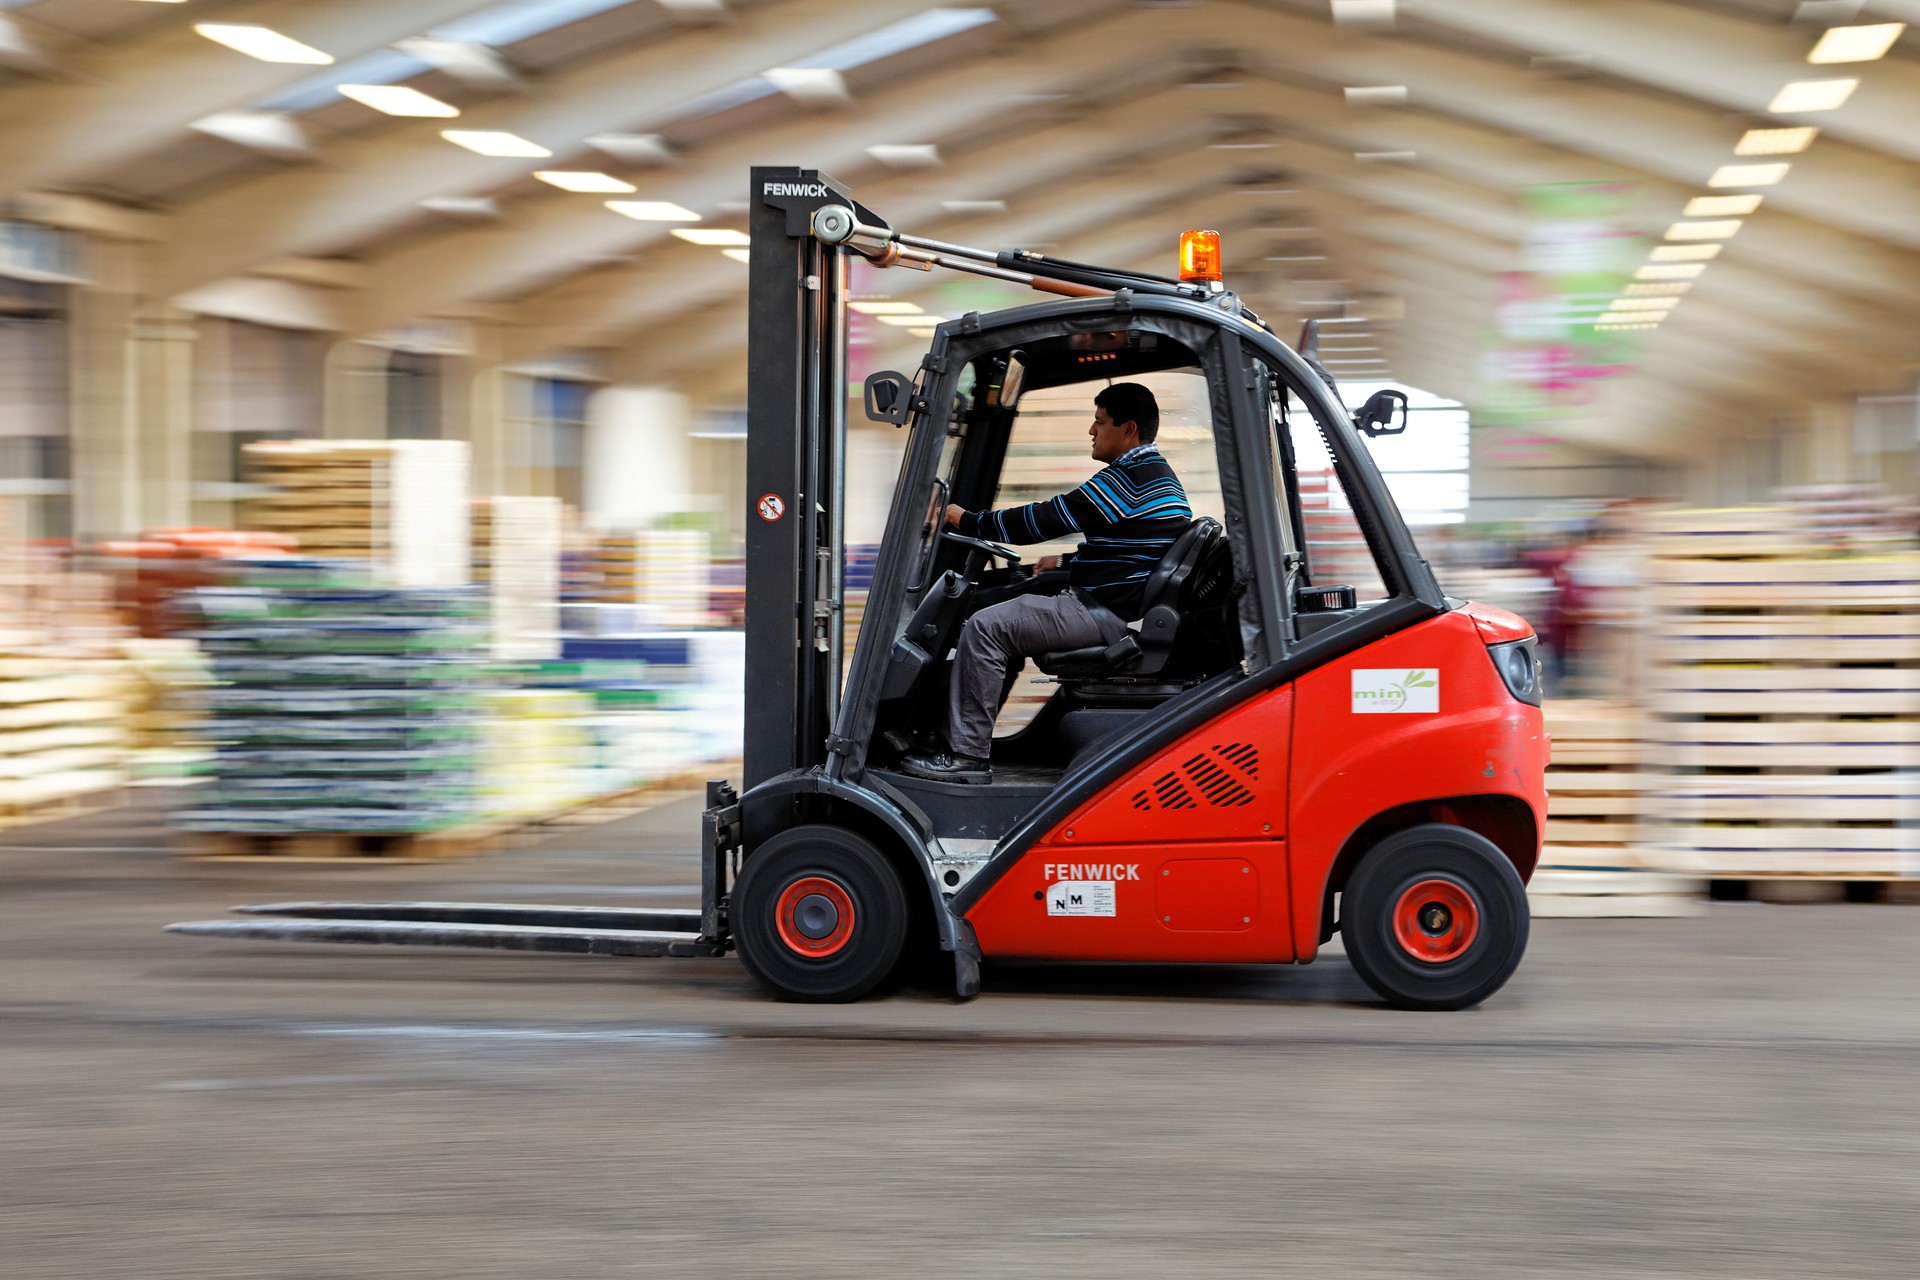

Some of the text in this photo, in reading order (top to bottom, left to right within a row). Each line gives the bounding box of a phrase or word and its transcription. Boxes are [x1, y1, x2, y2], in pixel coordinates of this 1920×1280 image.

[763, 182, 828, 198] FENWICK
[1044, 863, 1140, 881] FENWICK
[1056, 899, 1066, 910] N
[1070, 894, 1083, 905] M
